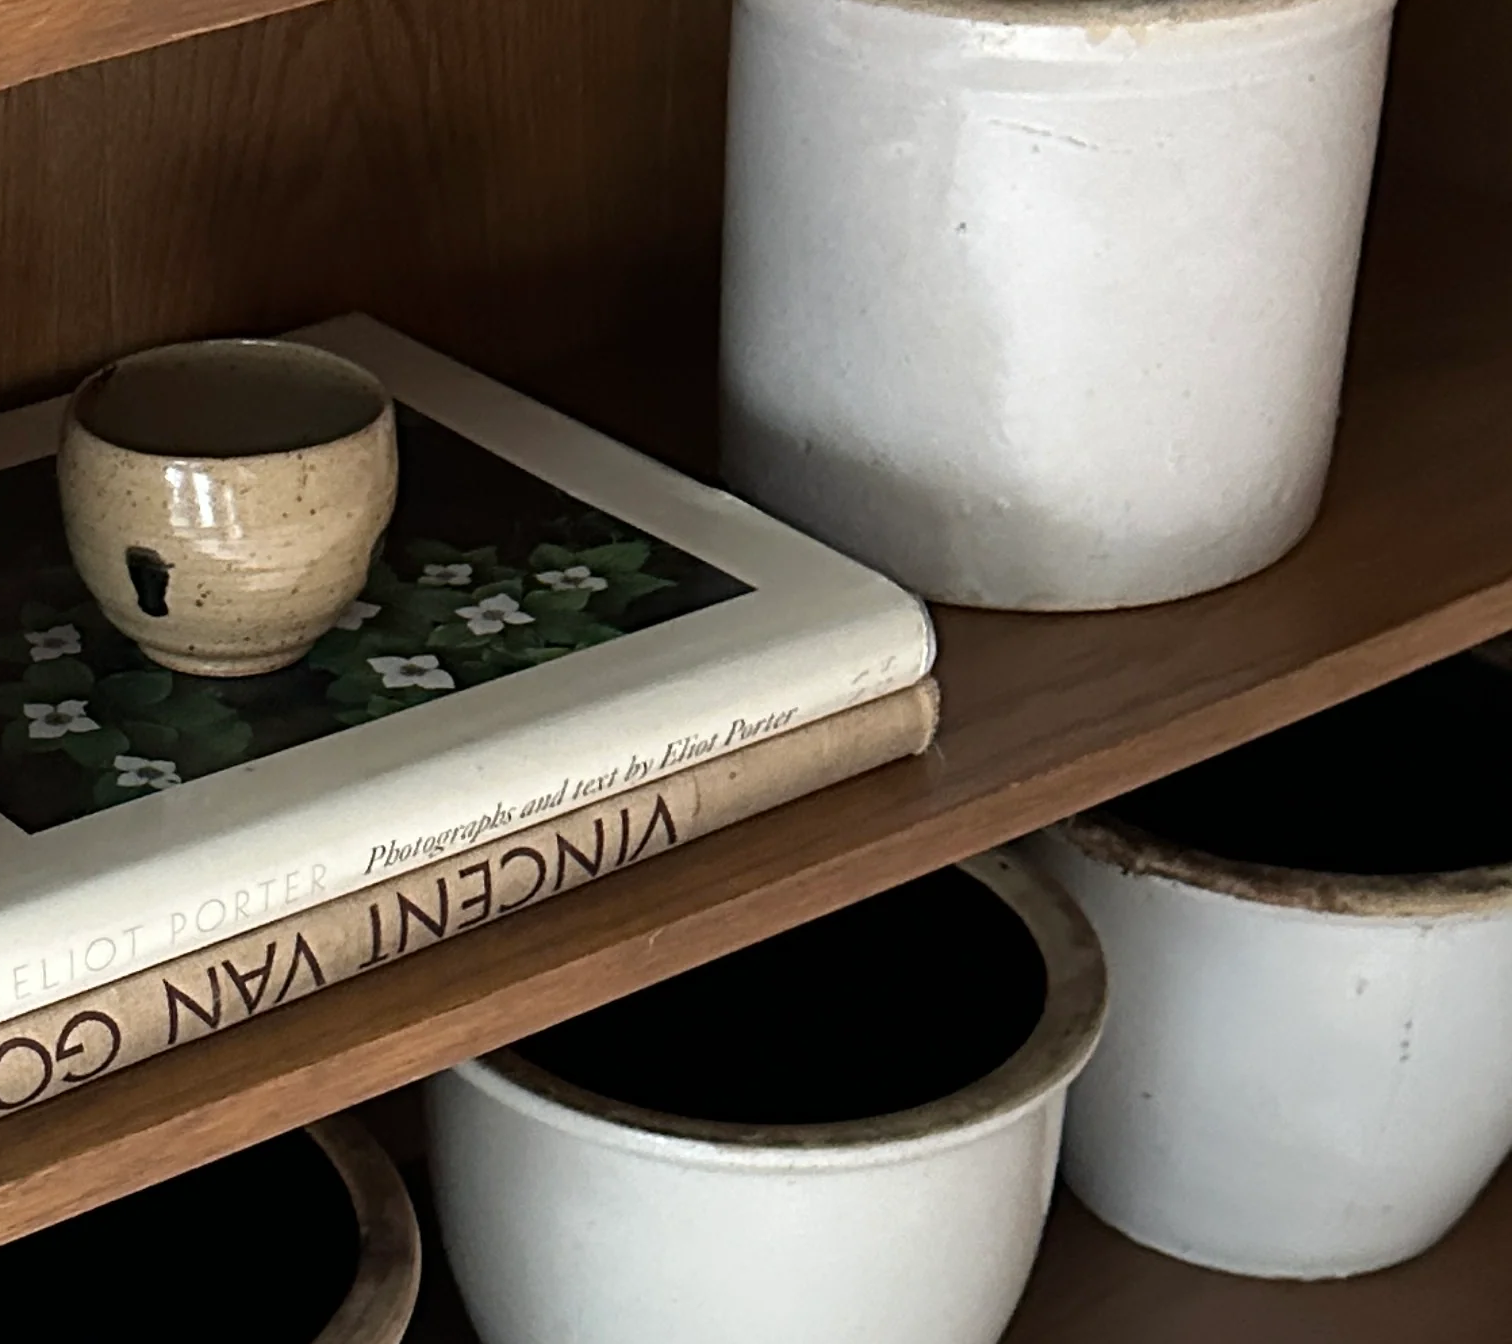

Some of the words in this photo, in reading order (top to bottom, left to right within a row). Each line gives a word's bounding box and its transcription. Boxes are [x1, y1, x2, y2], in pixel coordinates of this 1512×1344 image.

[364, 802, 517, 874] Photographs
[519, 778, 571, 820] and
[571, 764, 620, 804] text
[624, 754, 657, 784] by
[658, 737, 721, 768] Eliot
[723, 704, 801, 748] Porter
[12, 925, 145, 1000] ELIOT
[170, 862, 328, 945] PORTER
[358, 793, 679, 971] VINCENT
[162, 931, 326, 1045] VAN
